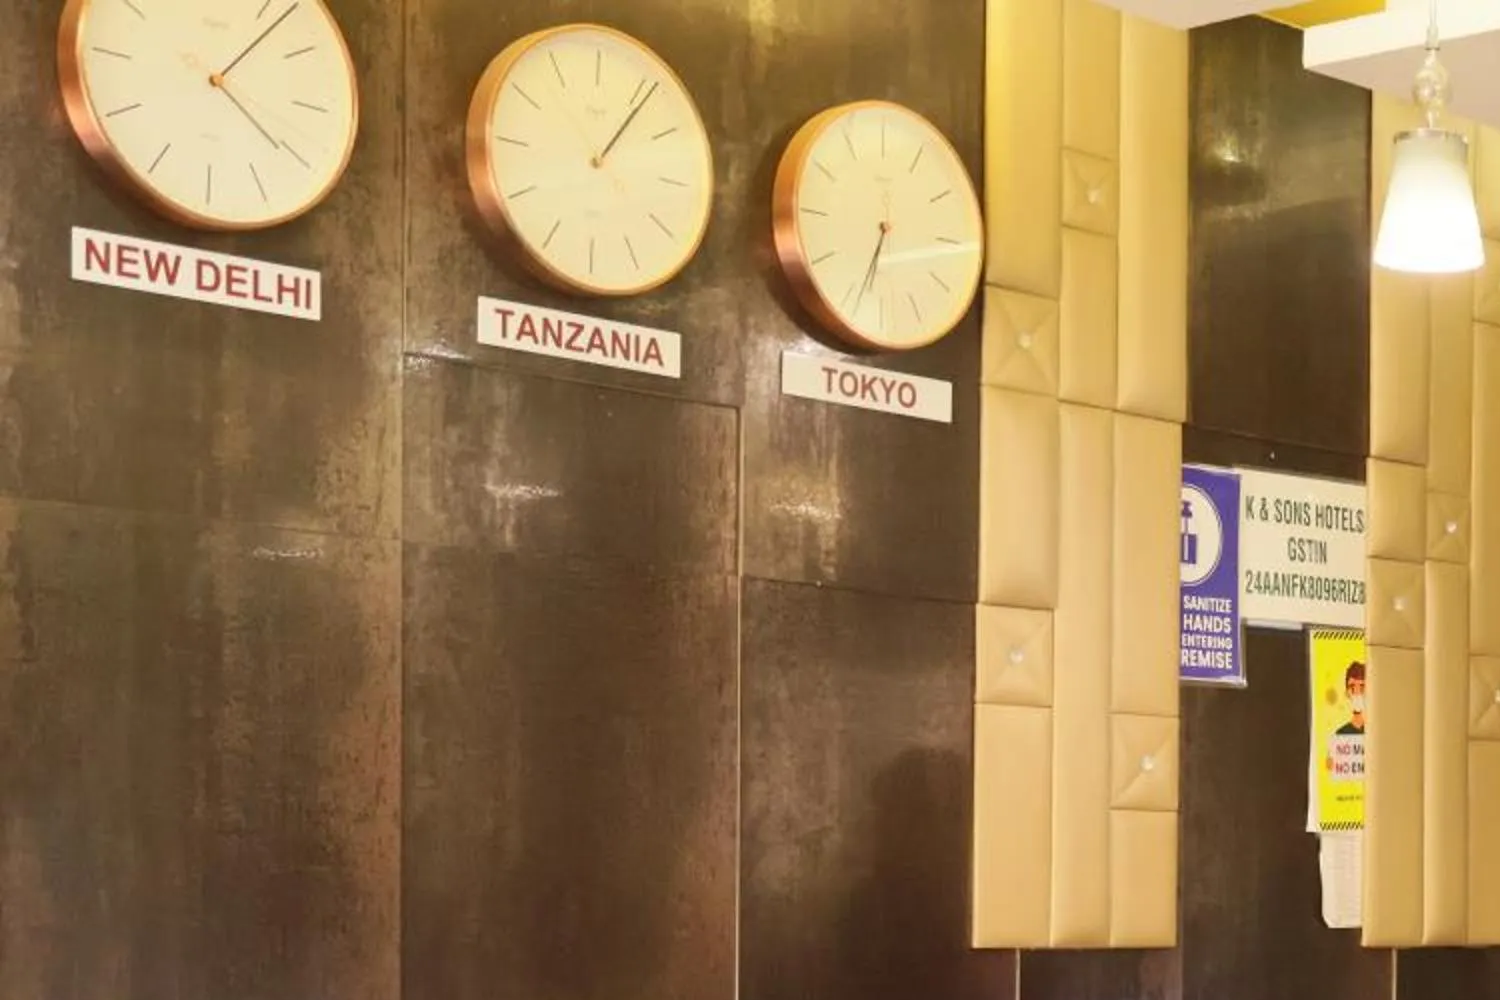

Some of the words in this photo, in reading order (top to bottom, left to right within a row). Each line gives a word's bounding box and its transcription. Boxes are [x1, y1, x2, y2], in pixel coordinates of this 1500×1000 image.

[85, 237, 182, 287] NEW
[195, 258, 312, 310] DELHI
[494, 307, 665, 368] TANZANIA
[821, 366, 917, 409] TOKYO
[1245, 495, 1255, 520] K
[1260, 497, 1269, 521] &
[1273, 498, 1311, 527] SONS
[1315, 503, 1365, 534] HOTELS
[1287, 536, 1328, 564] GSTIN
[1183, 594, 1233, 613] SANITIZE
[1183, 613, 1232, 634] HANDS
[1181, 633, 1233, 650] ENTERING
